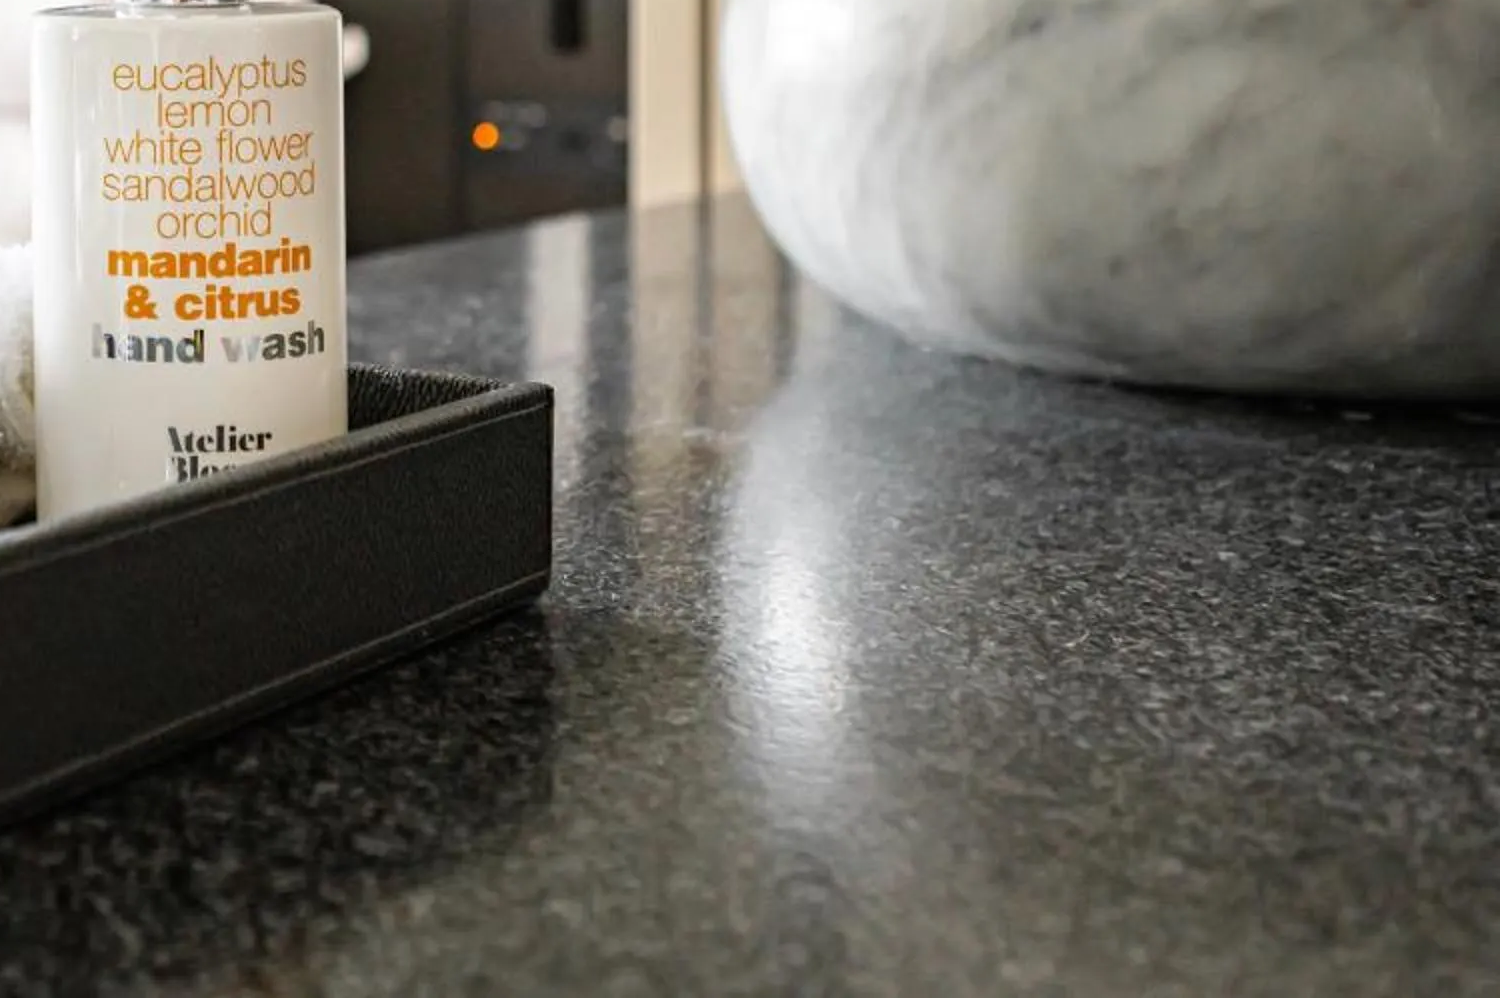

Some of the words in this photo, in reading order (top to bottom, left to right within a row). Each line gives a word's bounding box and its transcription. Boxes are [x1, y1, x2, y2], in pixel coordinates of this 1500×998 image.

[112, 55, 307, 97] eucalyptus
[157, 93, 272, 128] lemon
[103, 129, 202, 165] white
[216, 128, 315, 163] flower
[102, 160, 315, 202] sandalwood
[156, 201, 272, 239] orchid
[107, 238, 312, 279] mandarin
[124, 284, 158, 319] &
[174, 284, 301, 321] citrus
[92, 323, 205, 363] hand
[221, 319, 325, 362] wash
[167, 425, 272, 453] Atelier
